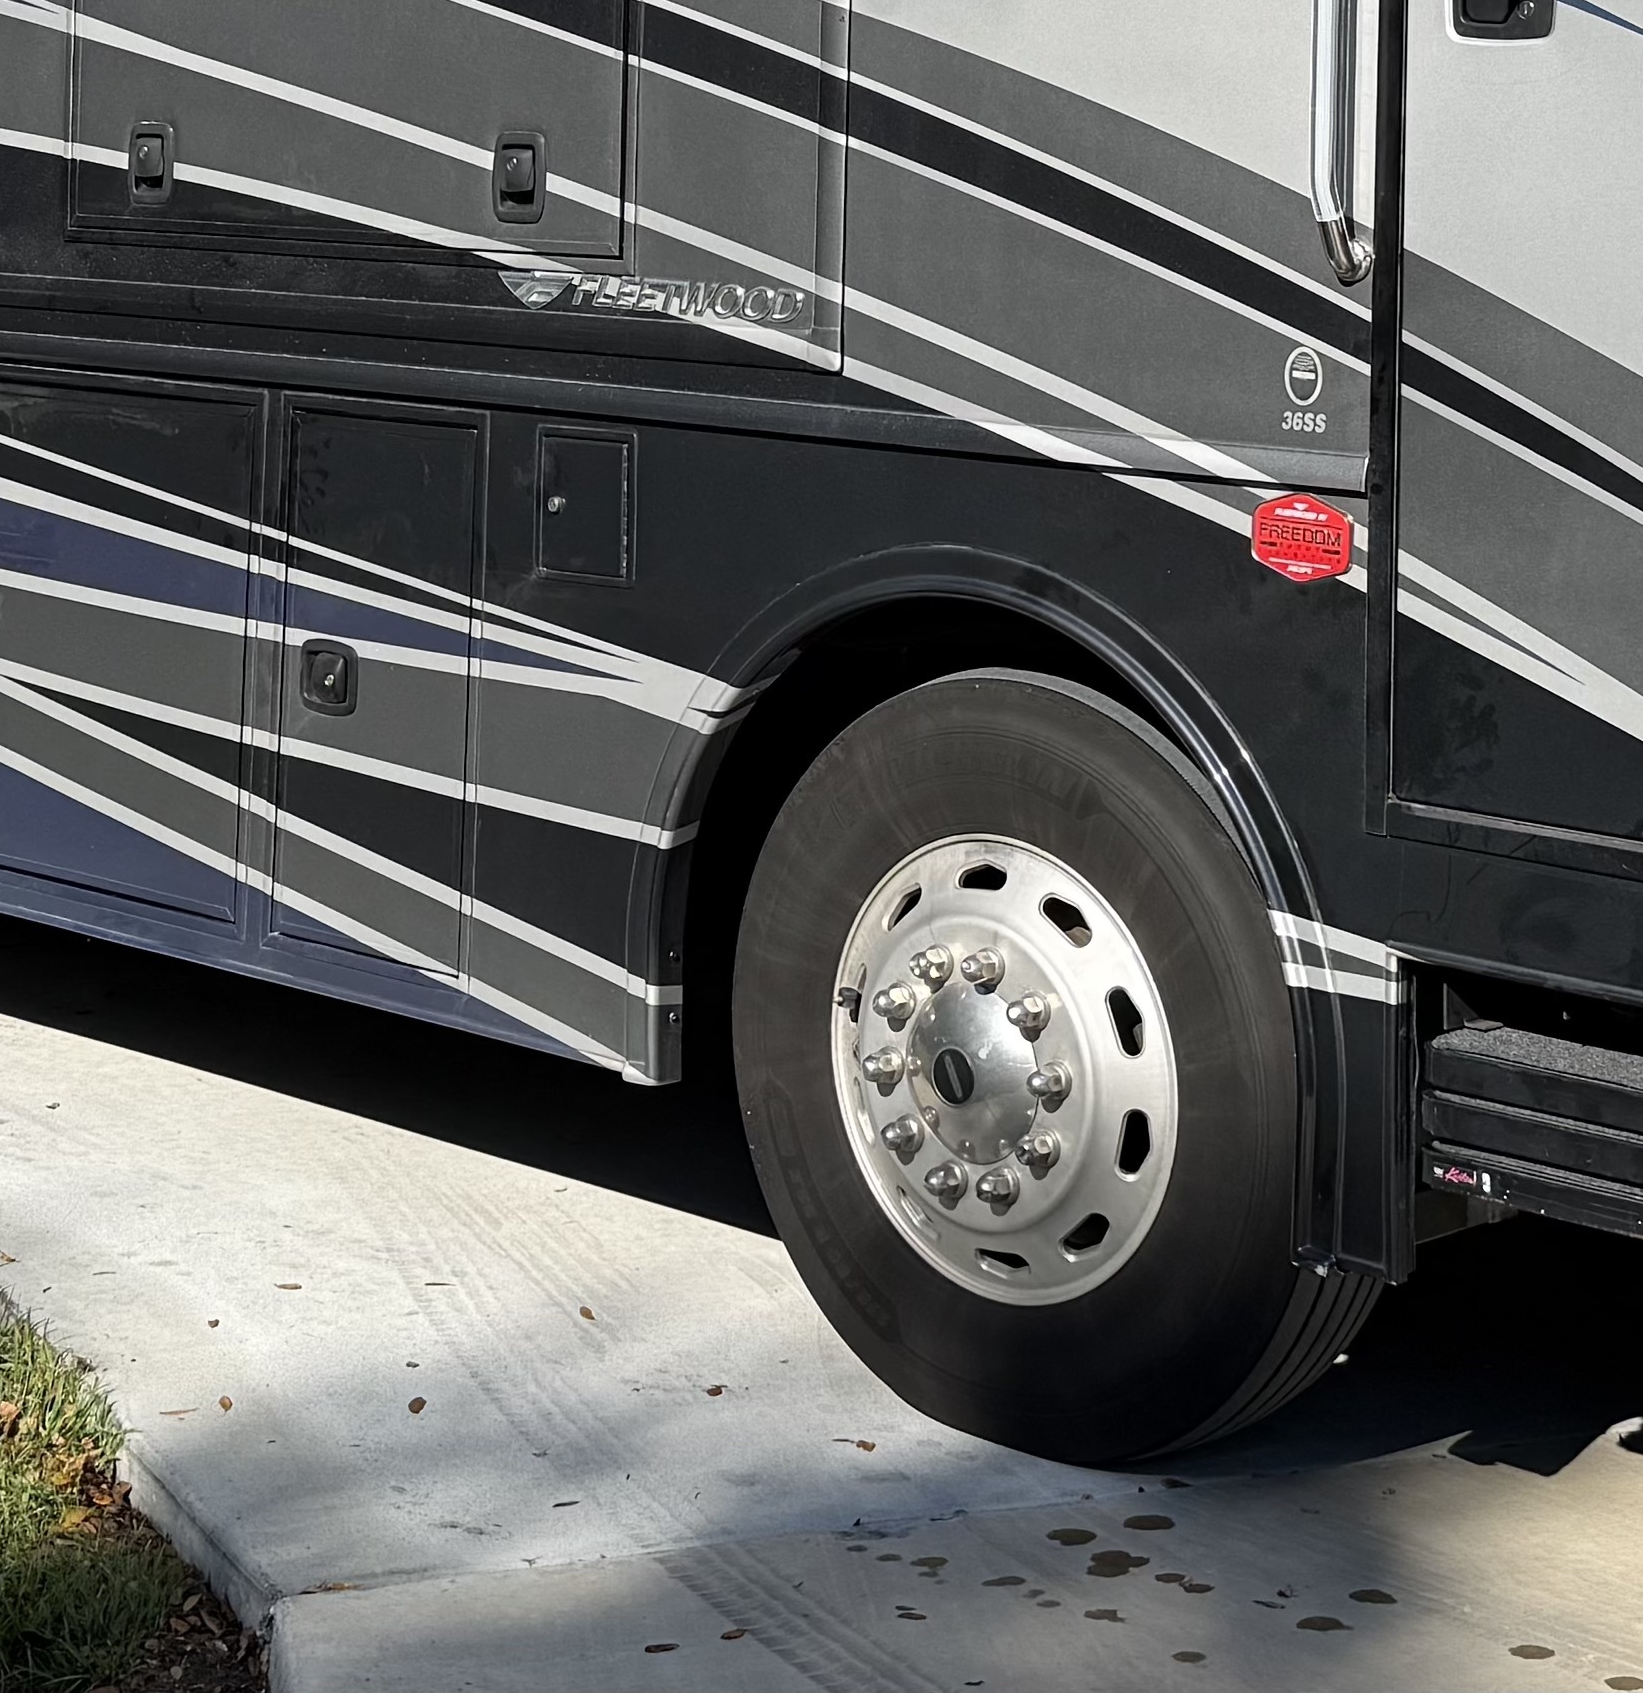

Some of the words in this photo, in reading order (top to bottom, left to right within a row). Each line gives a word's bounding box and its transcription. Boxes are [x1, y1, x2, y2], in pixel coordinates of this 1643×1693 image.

[571, 274, 806, 322] FLEETWOOD
[1282, 411, 1327, 433] 36SS
[1260, 522, 1341, 546] FREEDOM
